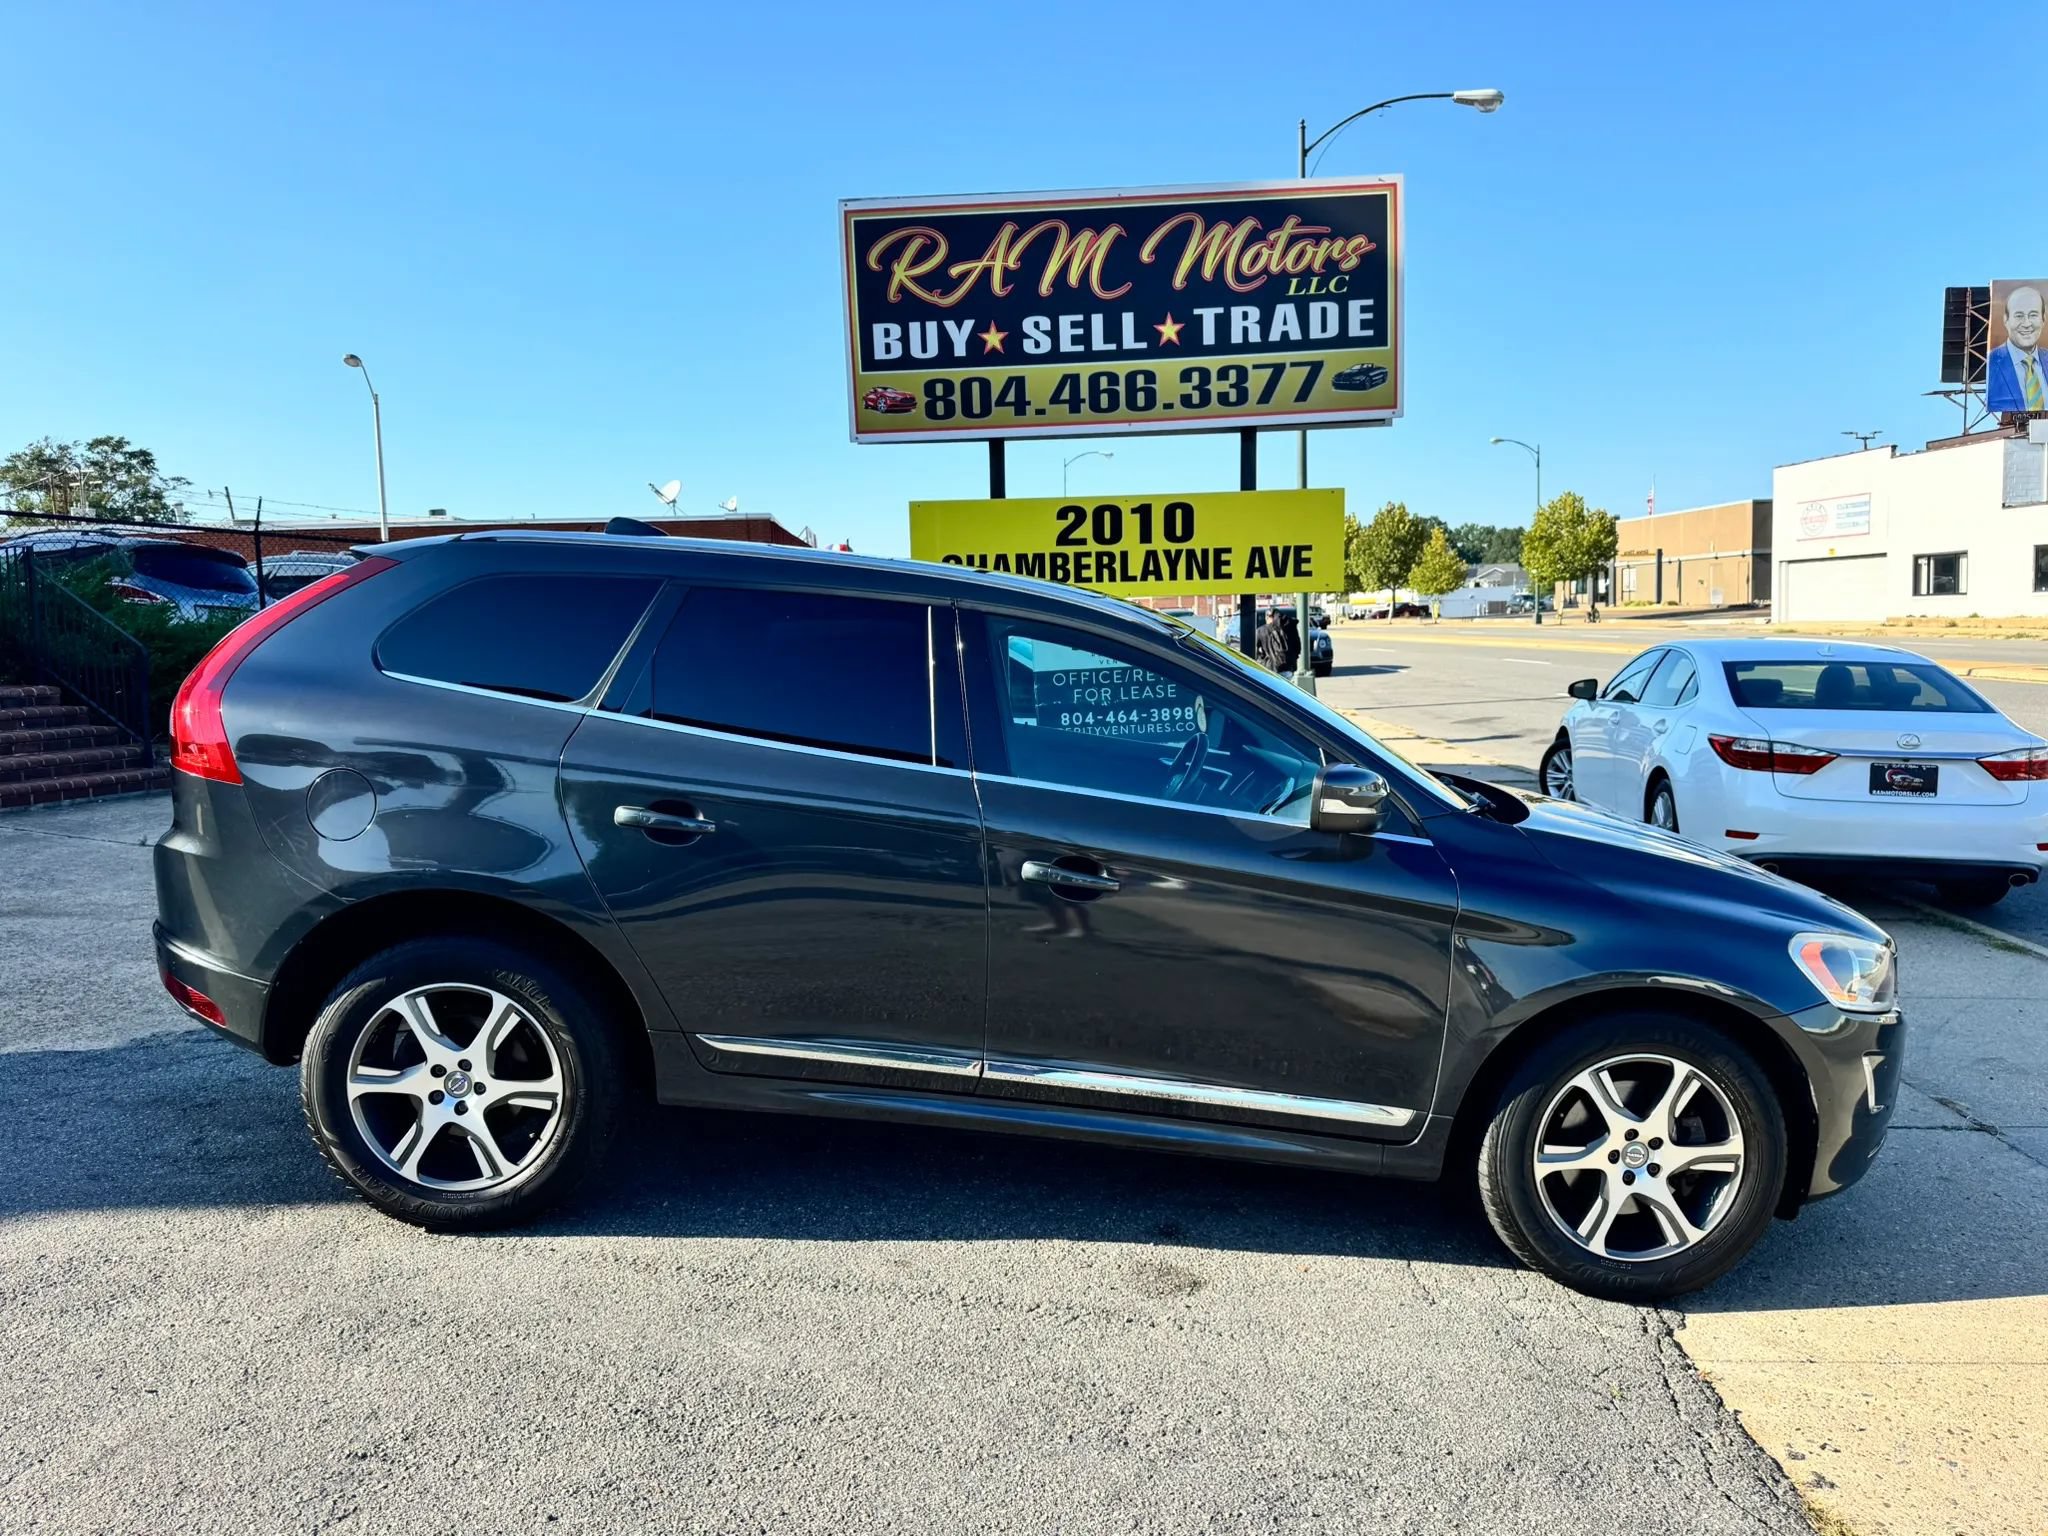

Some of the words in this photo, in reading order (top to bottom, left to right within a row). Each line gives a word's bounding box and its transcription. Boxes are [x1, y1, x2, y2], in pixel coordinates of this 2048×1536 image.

[868, 221, 1132, 307] RAM
[1140, 212, 1376, 294] Motors
[1285, 274, 1350, 296] LLC
[872, 318, 976, 360] BUY
[1021, 311, 1147, 354] SELL
[1193, 299, 1375, 346] TRADE
[923, 360, 1325, 421] 804.466.3377
[1055, 501, 1196, 547] 2010
[1244, 543, 1314, 579] AVE
[1052, 667, 1165, 687] OFFICE/RE
[1073, 687, 1112, 703] FOR
[1120, 683, 1177, 701] LEASE
[1060, 706, 1194, 726] 804-464-3898
